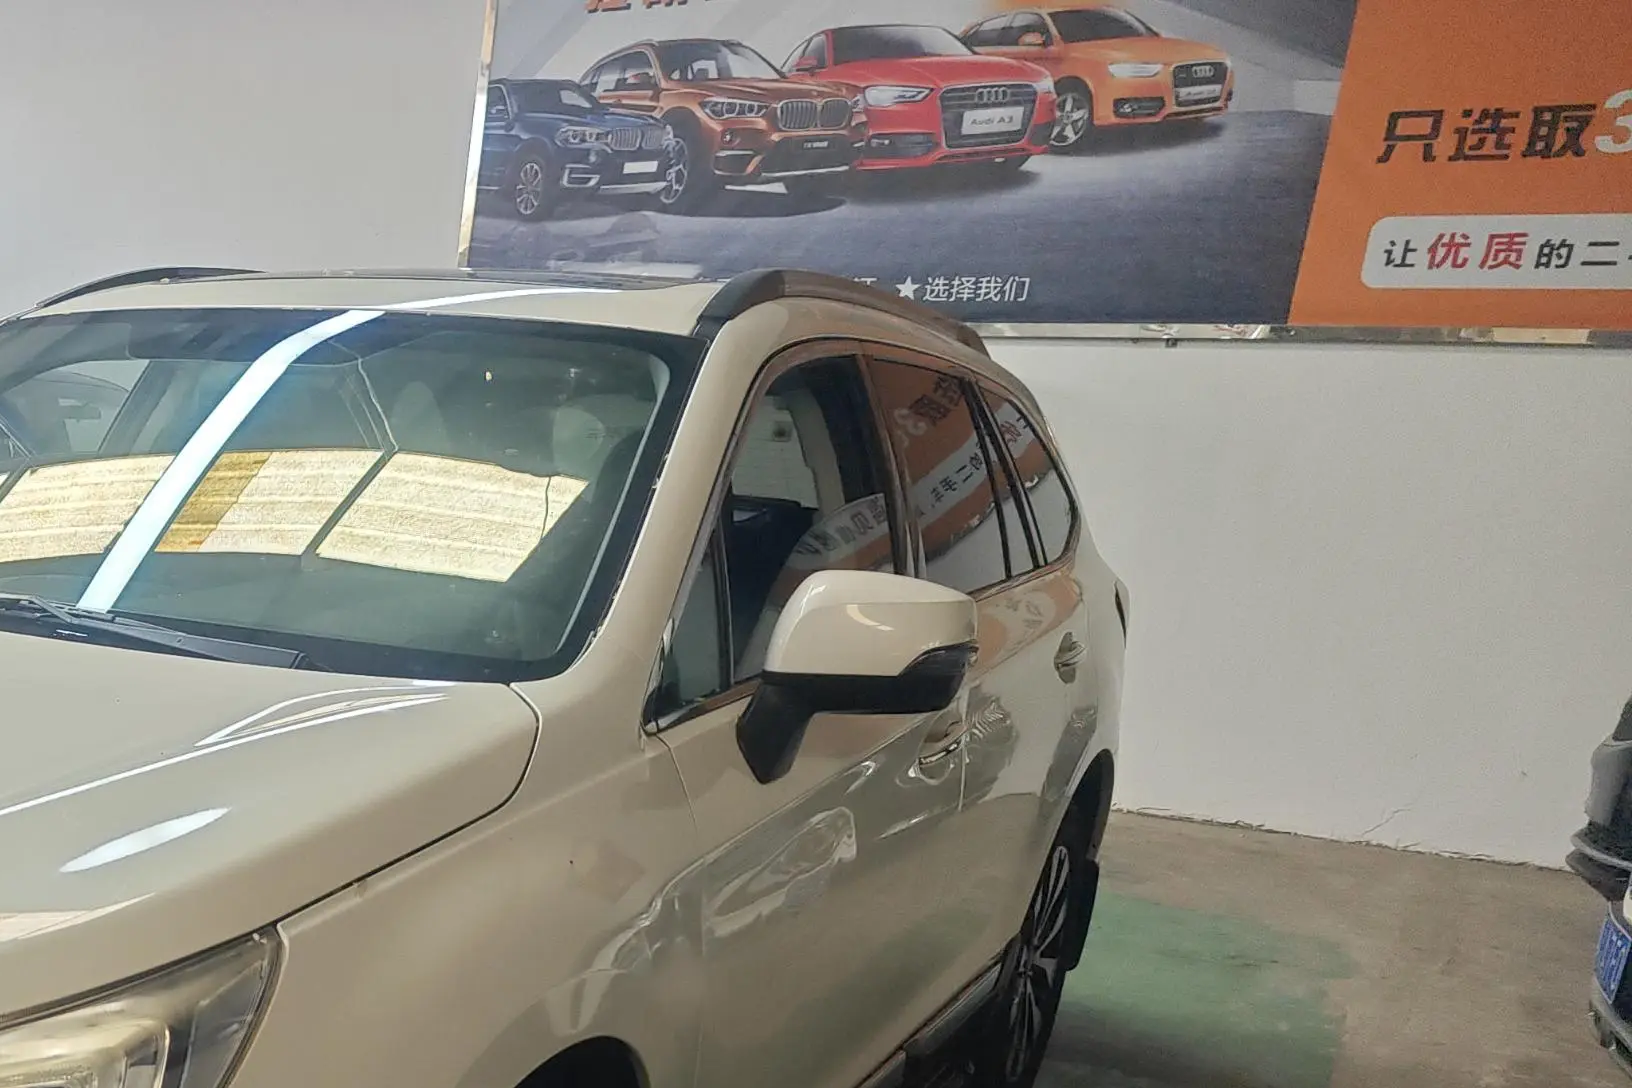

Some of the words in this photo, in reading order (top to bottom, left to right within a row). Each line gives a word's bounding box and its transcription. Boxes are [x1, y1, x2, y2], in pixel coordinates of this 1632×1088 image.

[1383, 231, 1632, 271] 让优质的二
[923, 276, 1030, 302] 选择我们
